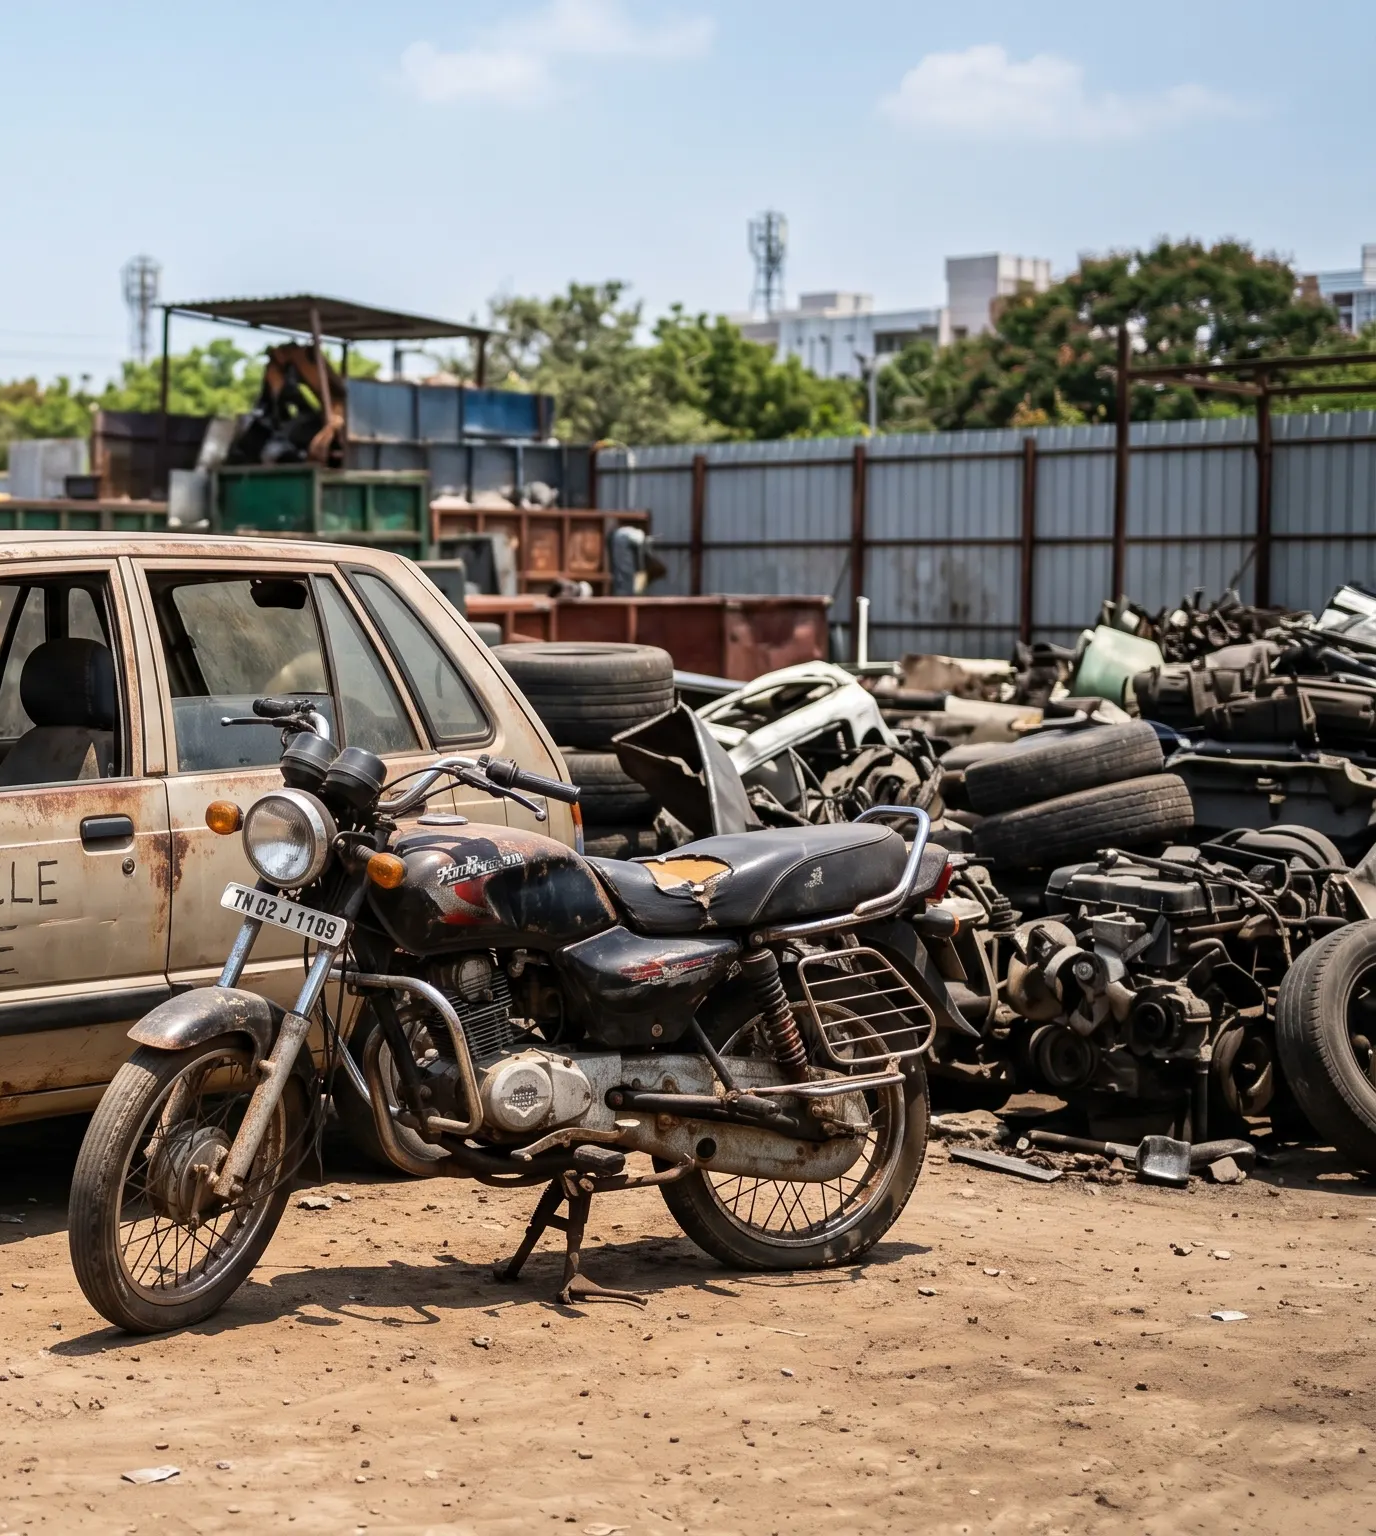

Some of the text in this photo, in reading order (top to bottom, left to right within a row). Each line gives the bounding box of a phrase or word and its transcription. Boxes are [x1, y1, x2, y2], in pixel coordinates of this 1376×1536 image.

[235, 889, 337, 940] TN 02 J 1109
